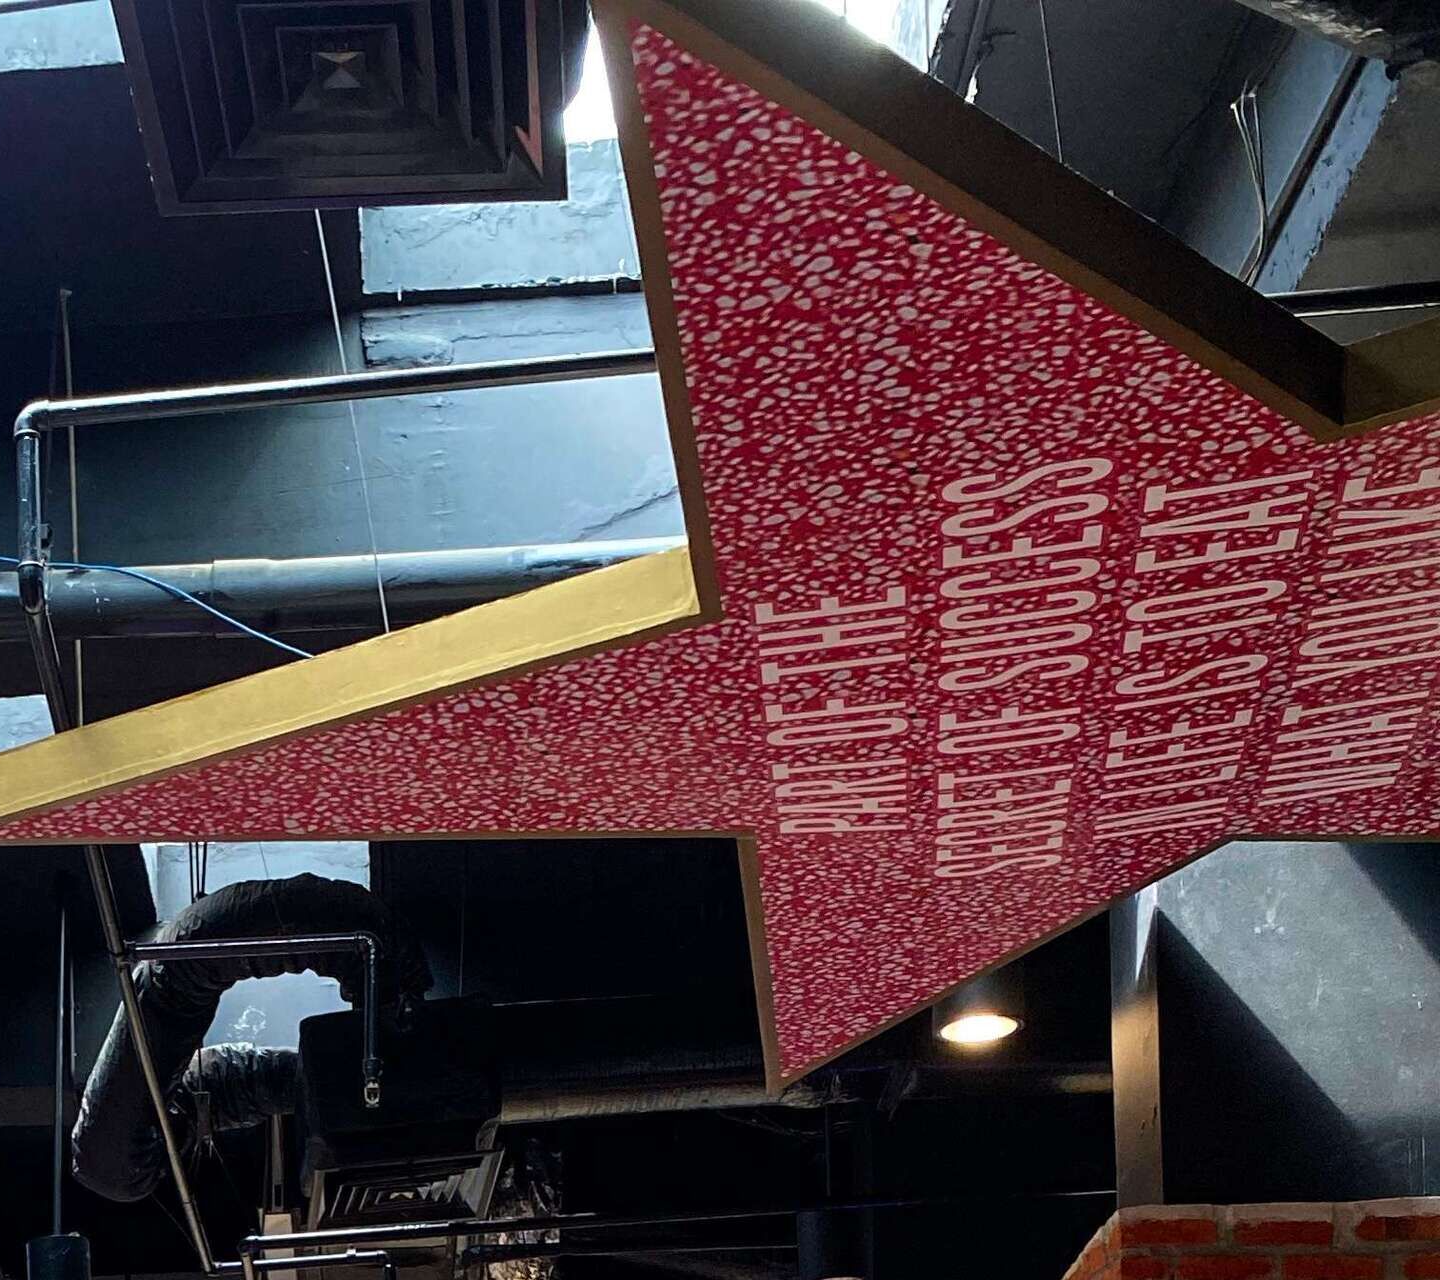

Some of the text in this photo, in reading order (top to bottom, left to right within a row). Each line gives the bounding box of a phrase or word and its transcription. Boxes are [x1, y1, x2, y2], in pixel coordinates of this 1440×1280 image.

[755, 585, 909, 834] PART OF THE
[934, 457, 1113, 879] SECRET OF SUCCESS
[1092, 470, 1314, 841] IN LIFE IS TO EAT
[1259, 689, 1430, 807] WHAT
[1291, 588, 1440, 688] YOU
